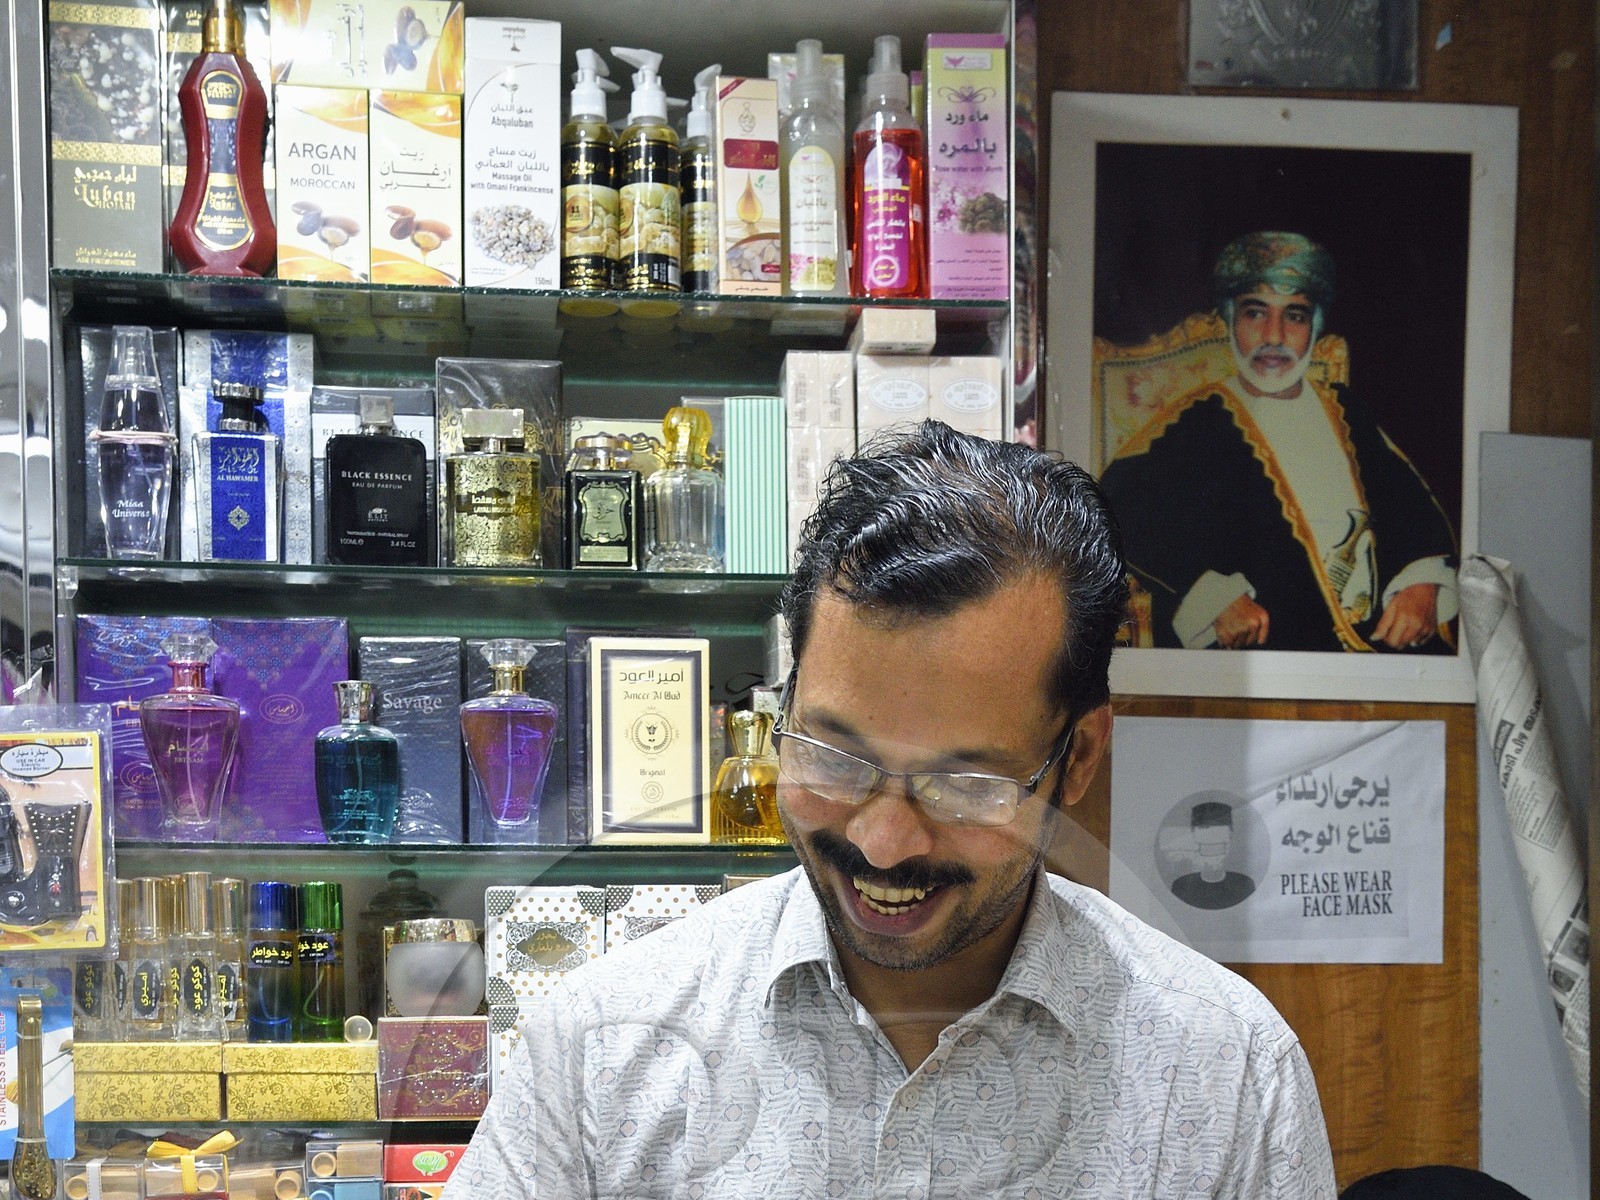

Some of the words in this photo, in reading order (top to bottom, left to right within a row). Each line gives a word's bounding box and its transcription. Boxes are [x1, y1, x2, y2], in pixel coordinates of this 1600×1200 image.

[491, 116, 534, 128] Abqaluban
[288, 142, 357, 161] ARGAN
[311, 163, 335, 176] OIL
[290, 177, 356, 190] MOROCCAN
[492, 172, 522, 182] Massage
[523, 173, 532, 181] Oil
[487, 182, 508, 191] Omani
[509, 183, 554, 194] Frankincense
[341, 470, 371, 480] BLACK
[374, 472, 413, 482] ESSENCE
[117, 499, 144, 508] Miss
[112, 508, 150, 518] Universe
[619, 670, 656, 685] العود
[656, 668, 684, 684] أمير
[383, 693, 442, 714] Savage
[1334, 775, 1390, 810] يرجى
[1281, 821, 1341, 854] الوجه
[1346, 817, 1391, 854] قناع
[1281, 872, 1340, 895] PLEASE
[1343, 870, 1392, 893] WEAR
[1302, 895, 1342, 917] FACE
[1345, 893, 1393, 916] MASK
[251, 946, 279, 959] خواطر
[311, 941, 329, 952] عود
